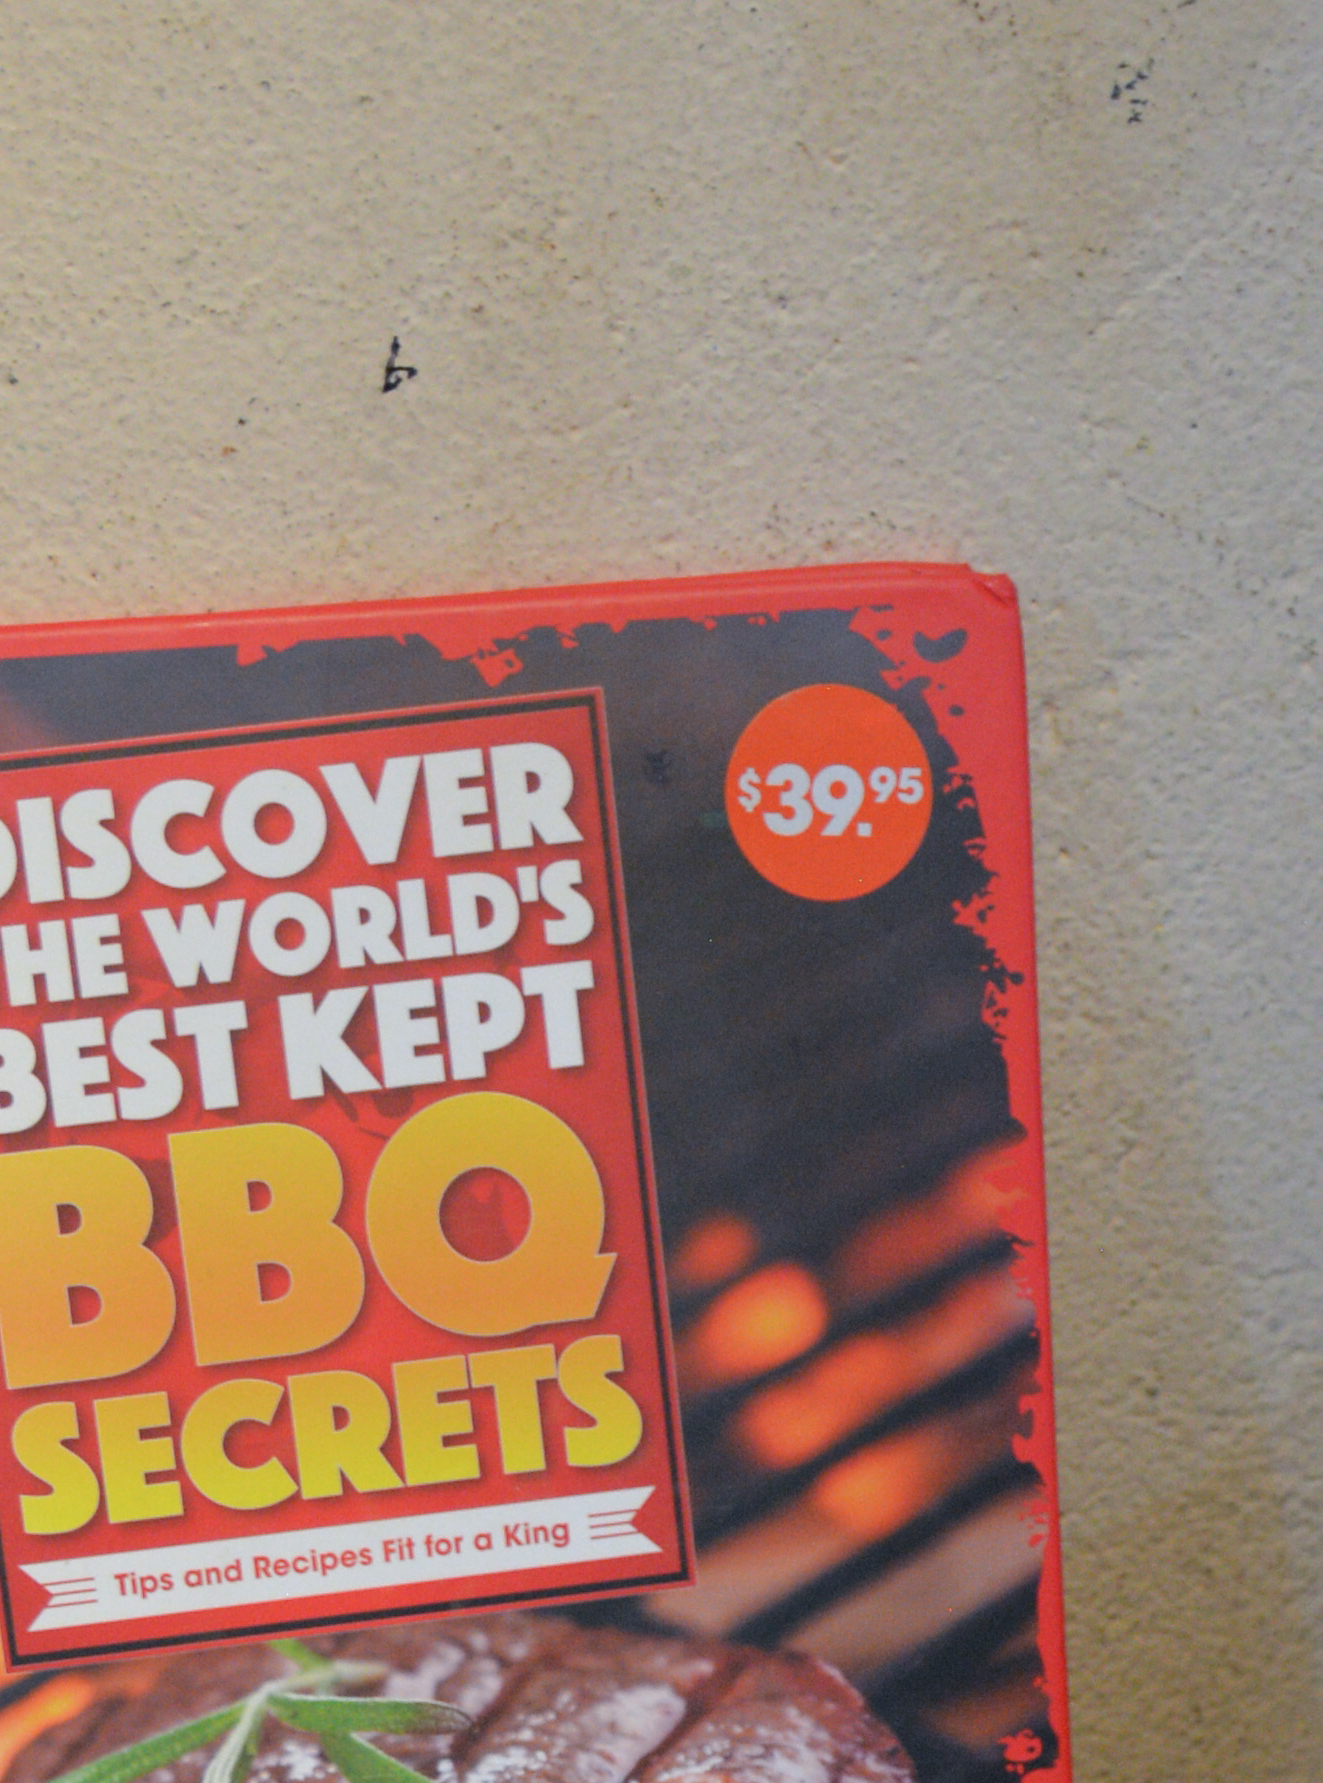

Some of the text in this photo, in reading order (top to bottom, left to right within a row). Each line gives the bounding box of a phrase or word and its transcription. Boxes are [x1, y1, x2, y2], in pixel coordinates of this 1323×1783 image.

[144, 859, 594, 986] WORLD'S
[281, 962, 594, 1100] KEPT
[12, 1335, 645, 1536] SECRETS
[114, 1521, 571, 1600] Tips and Recipes Fit for a King
